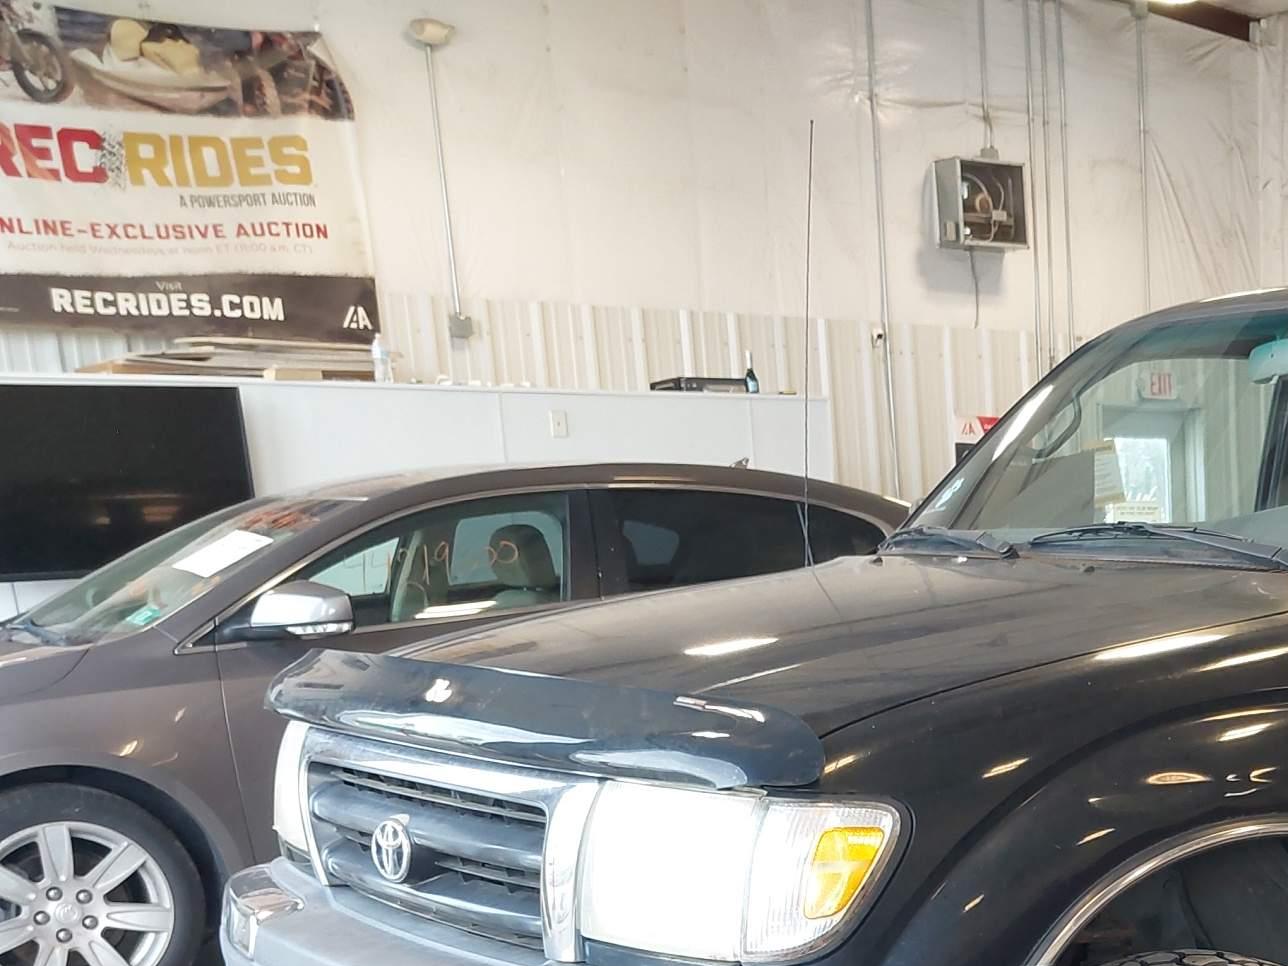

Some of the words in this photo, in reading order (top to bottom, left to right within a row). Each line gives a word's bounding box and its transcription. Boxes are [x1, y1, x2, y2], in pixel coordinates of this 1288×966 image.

[123, 132, 313, 188] RIDES
[180, 195, 188, 208] A
[190, 193, 268, 208] POWERSPORT
[271, 192, 316, 208] AUCTION
[235, 221, 329, 239] AUCTION
[156, 281, 183, 290] Visit
[50, 287, 285, 321] RECRIDES.COM
